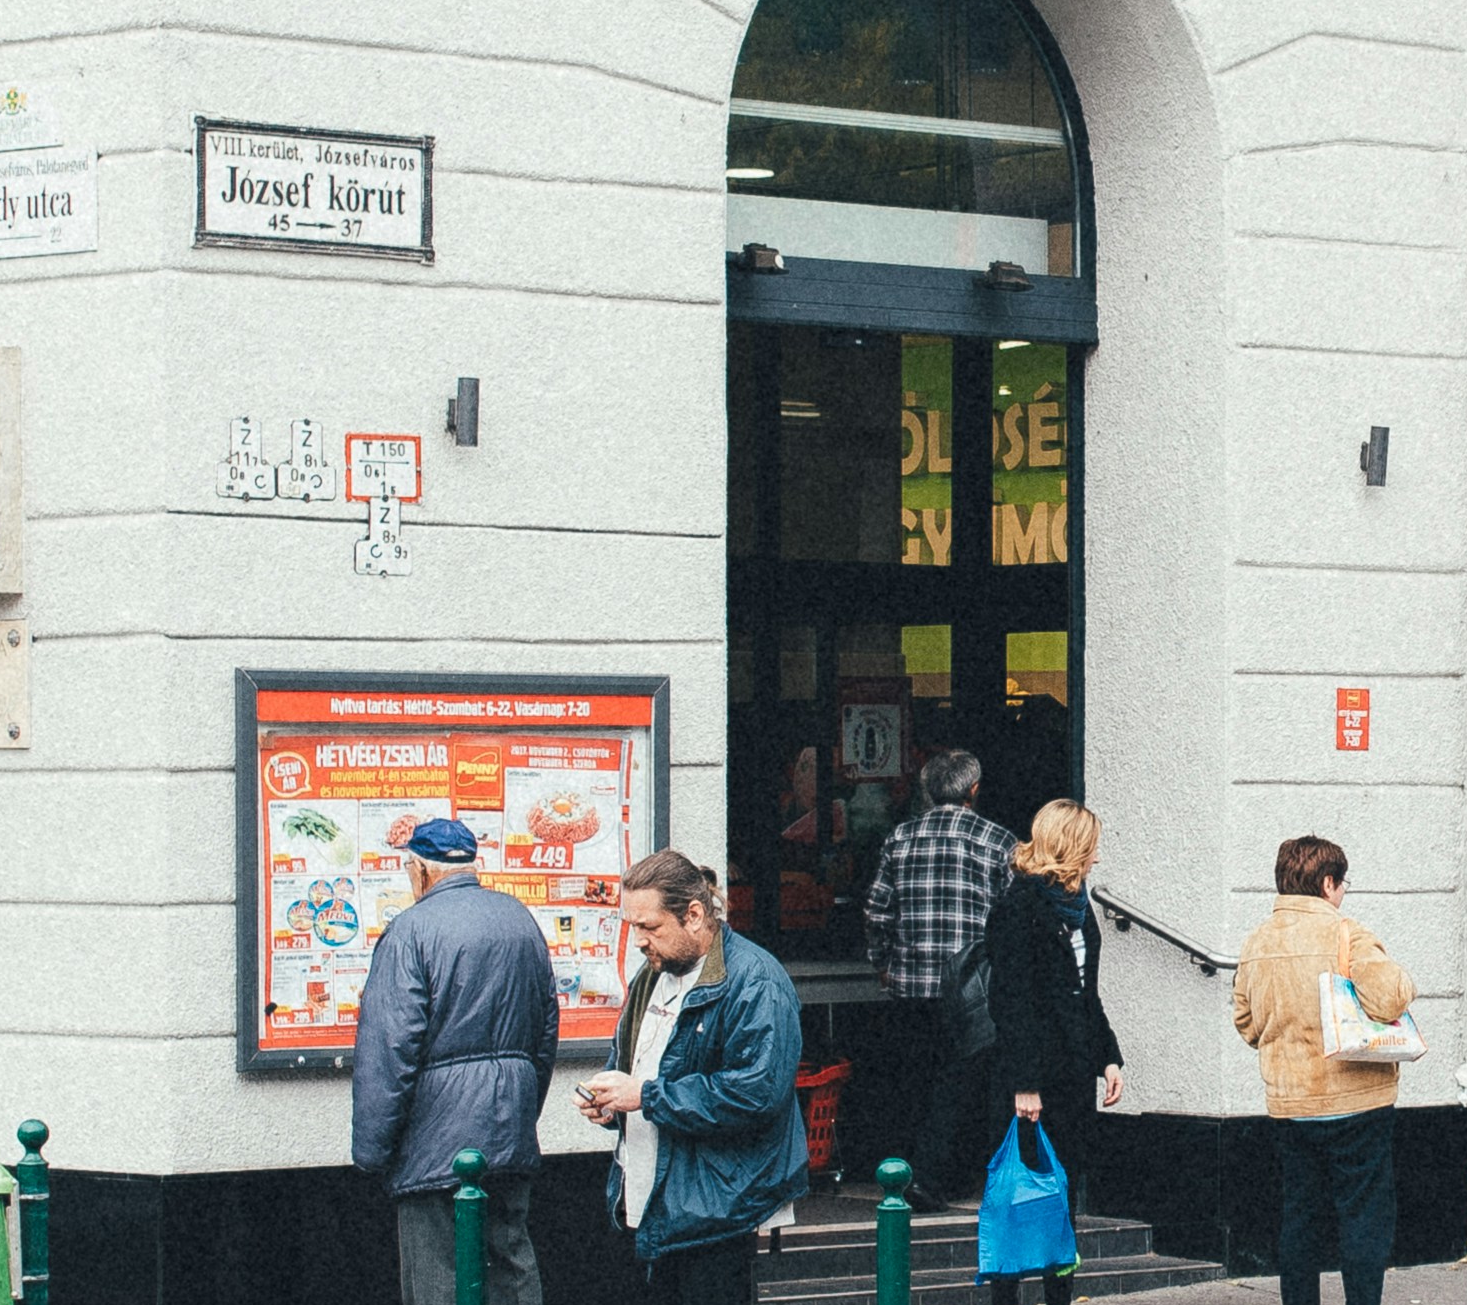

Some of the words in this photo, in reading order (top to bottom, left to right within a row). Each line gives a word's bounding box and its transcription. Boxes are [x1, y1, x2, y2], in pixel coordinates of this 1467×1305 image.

[209, 135, 246, 156] VIII.
[248, 140, 304, 164] kerület,
[315, 144, 415, 172] Józsefváros
[221, 165, 314, 209] József
[328, 174, 406, 215] körút
[27, 183, 73, 220] utca
[268, 213, 291, 232] 45
[341, 219, 363, 239] 37
[240, 428, 252, 445] Z
[301, 430, 313, 447] Z
[362, 441, 374, 456] T
[380, 443, 406, 457] 150
[380, 507, 391, 524] Z
[331, 697, 366, 716] Nyitva
[367, 698, 402, 715] tartás:
[486, 701, 514, 718] 6-22,
[514, 701, 567, 717] Vasárnap:
[567, 702, 590, 716] 7-20
[316, 742, 381, 767] HÉTVÉGI
[382, 744, 424, 767] ZSENI
[427, 742, 449, 767] ÁR
[274, 761, 302, 778] ZSENI
[330, 770, 377, 783] november
[401, 770, 450, 783] szombaton
[457, 760, 500, 776] PENNY
[283, 776, 297, 791] ÁR
[320, 784, 333, 798] és
[333, 784, 381, 798] november
